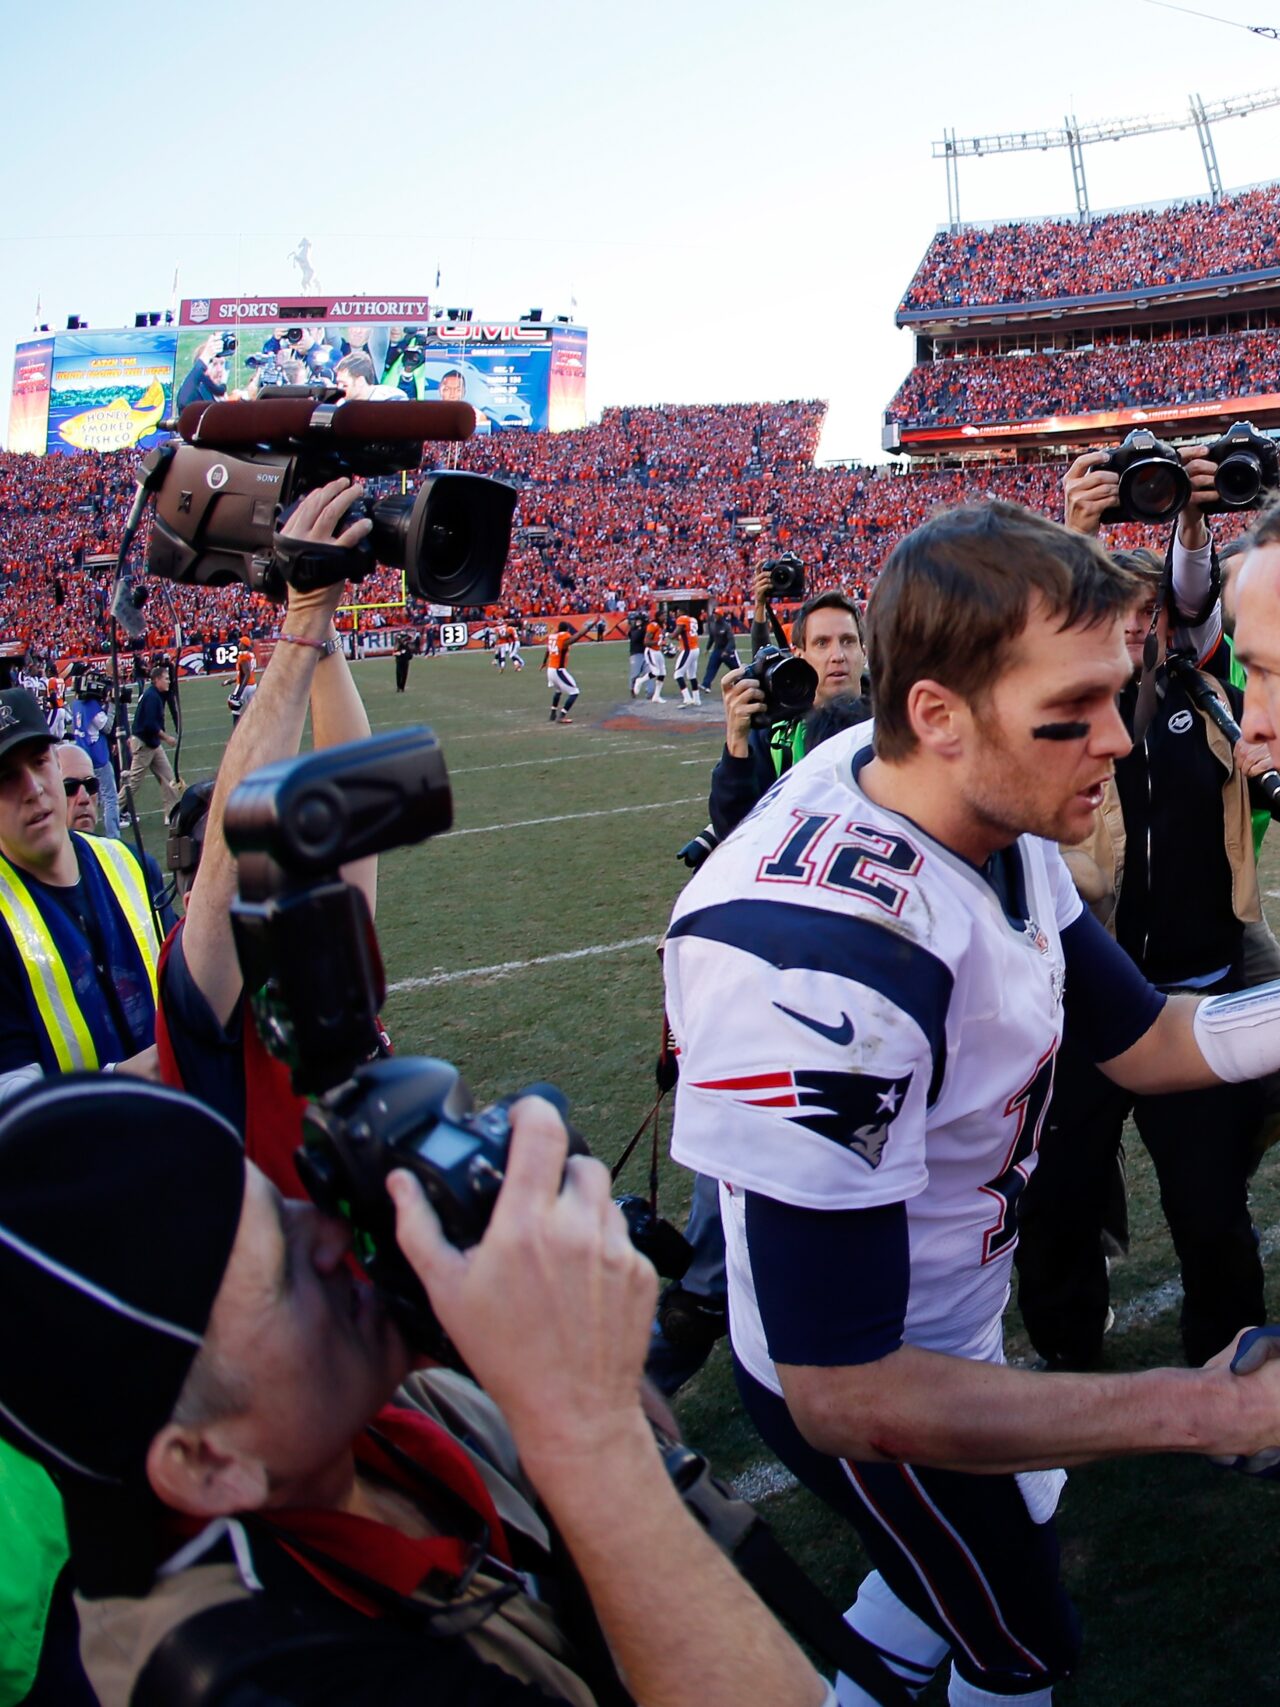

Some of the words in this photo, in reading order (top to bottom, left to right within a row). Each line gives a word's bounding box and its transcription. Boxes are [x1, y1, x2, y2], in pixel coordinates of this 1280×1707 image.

[218, 302, 279, 318] SPORTS
[329, 301, 427, 316] AUTHORITY
[87, 410, 129, 422] HONEY
[81, 421, 134, 433] SMOKED
[84, 434, 110, 444] FISH
[114, 432, 131, 443] CO
[256, 473, 280, 483] SONY
[444, 625, 464, 644] 33
[215, 645, 239, 665] 0:2
[755, 807, 925, 917] 12
